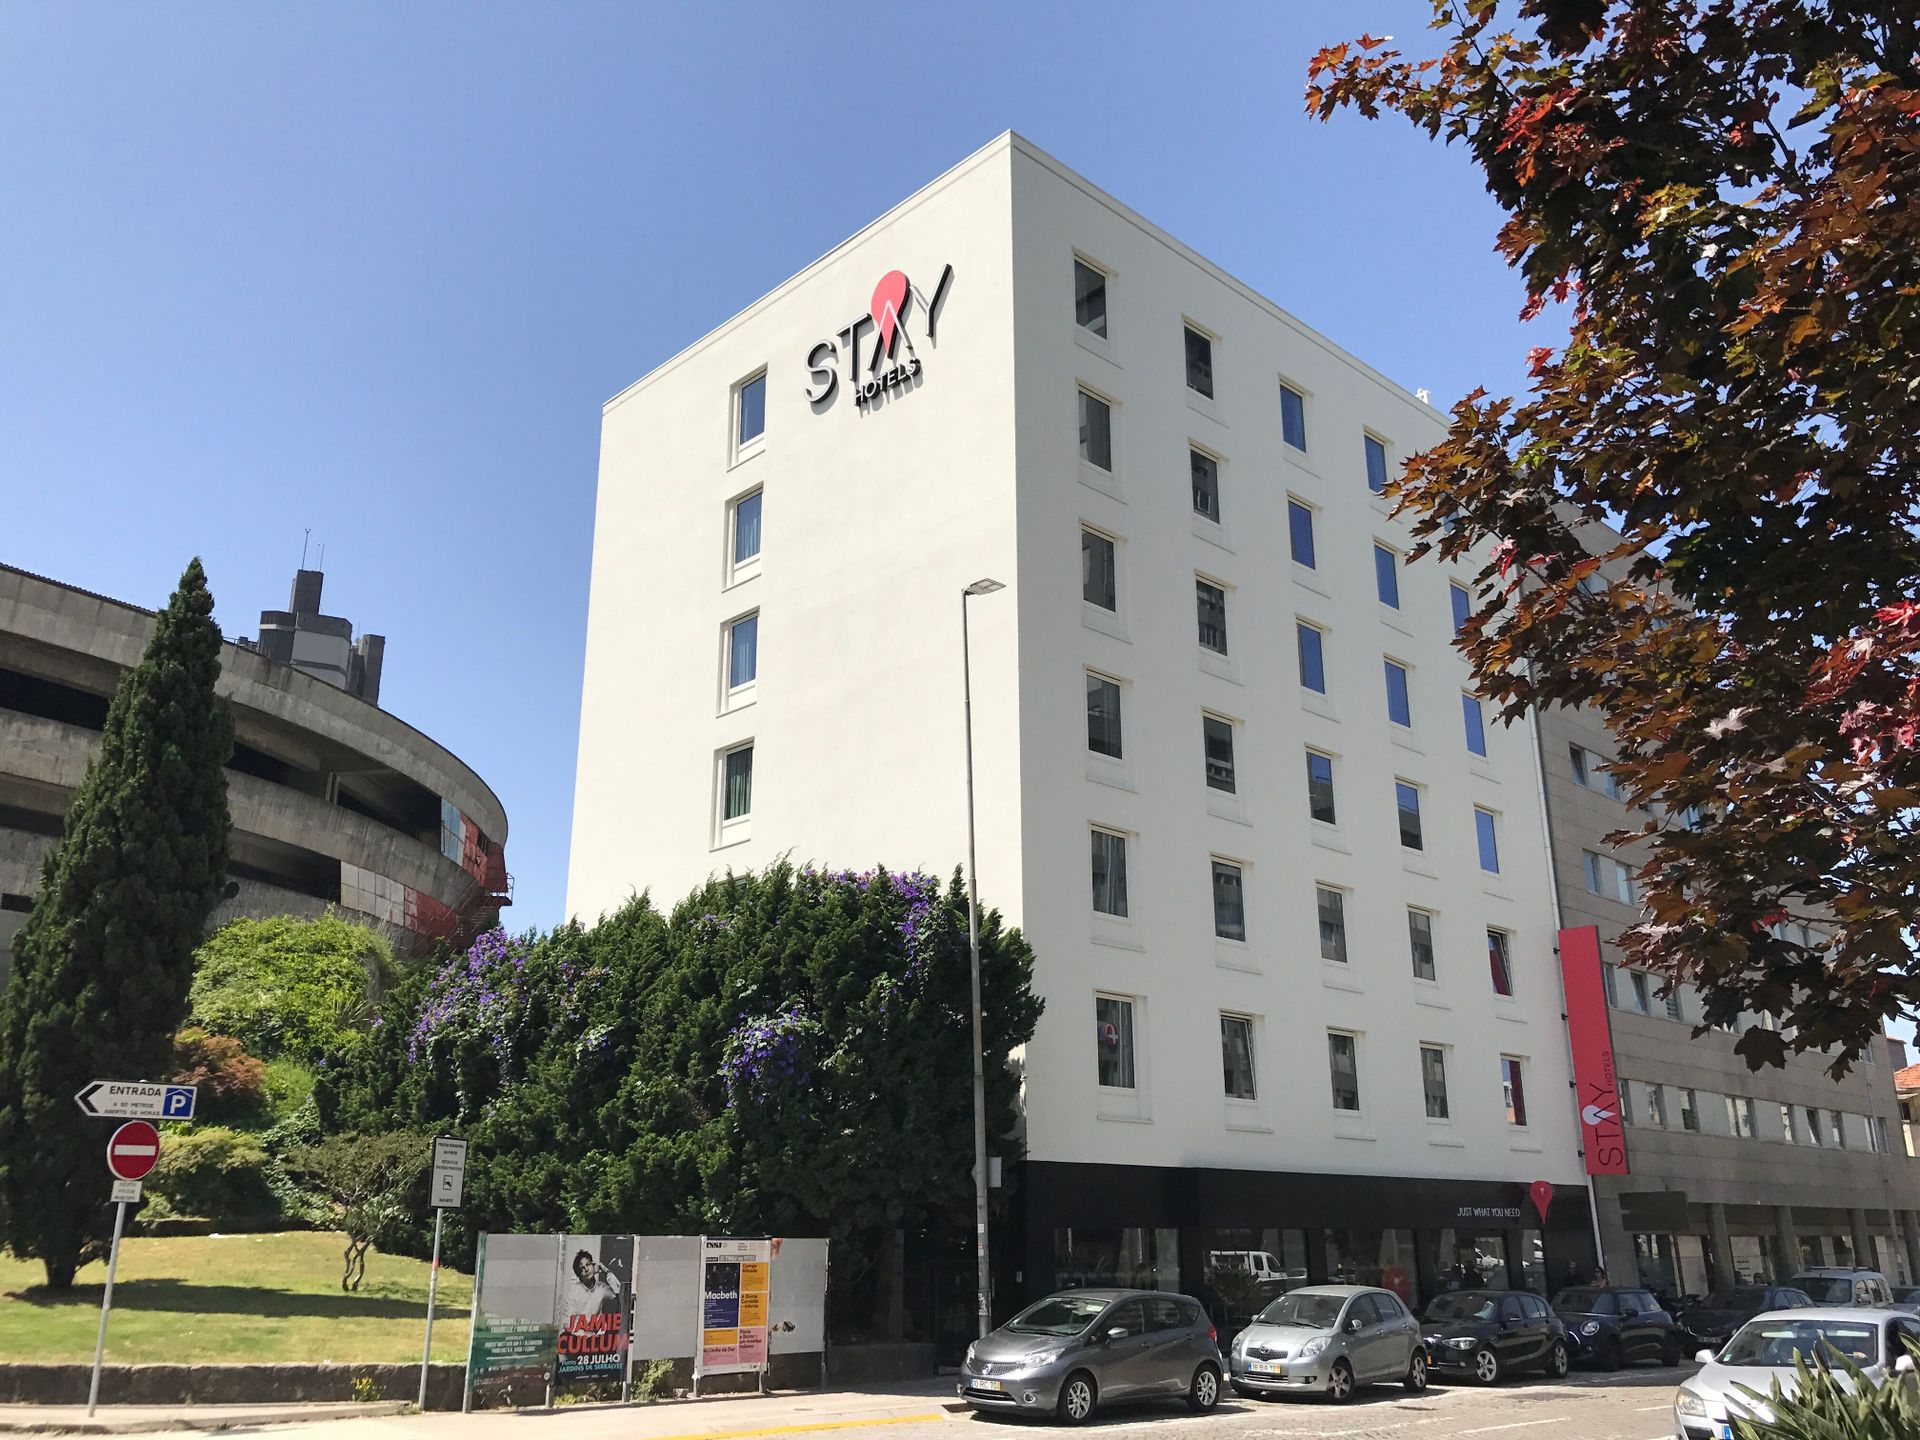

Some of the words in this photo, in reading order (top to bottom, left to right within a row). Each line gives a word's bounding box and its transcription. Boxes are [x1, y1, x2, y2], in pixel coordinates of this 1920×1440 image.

[804, 263, 954, 404] STAY
[855, 357, 921, 407] HOTELS
[109, 1085, 162, 1097] ENTRADA
[169, 1094, 187, 1114] P
[1589, 1082, 1623, 1167] STAY
[1456, 1207, 1472, 1217] JUST
[1473, 1207, 1490, 1217] WHAT
[1491, 1207, 1504, 1217] YOU
[1504, 1207, 1521, 1217] NEED
[704, 1290, 738, 1300] Macbeth
[567, 1312, 622, 1333] JAMIE
[556, 1332, 630, 1355] CULLUM
[577, 1355, 590, 1365] 28
[590, 1353, 621, 1365] JULHO
